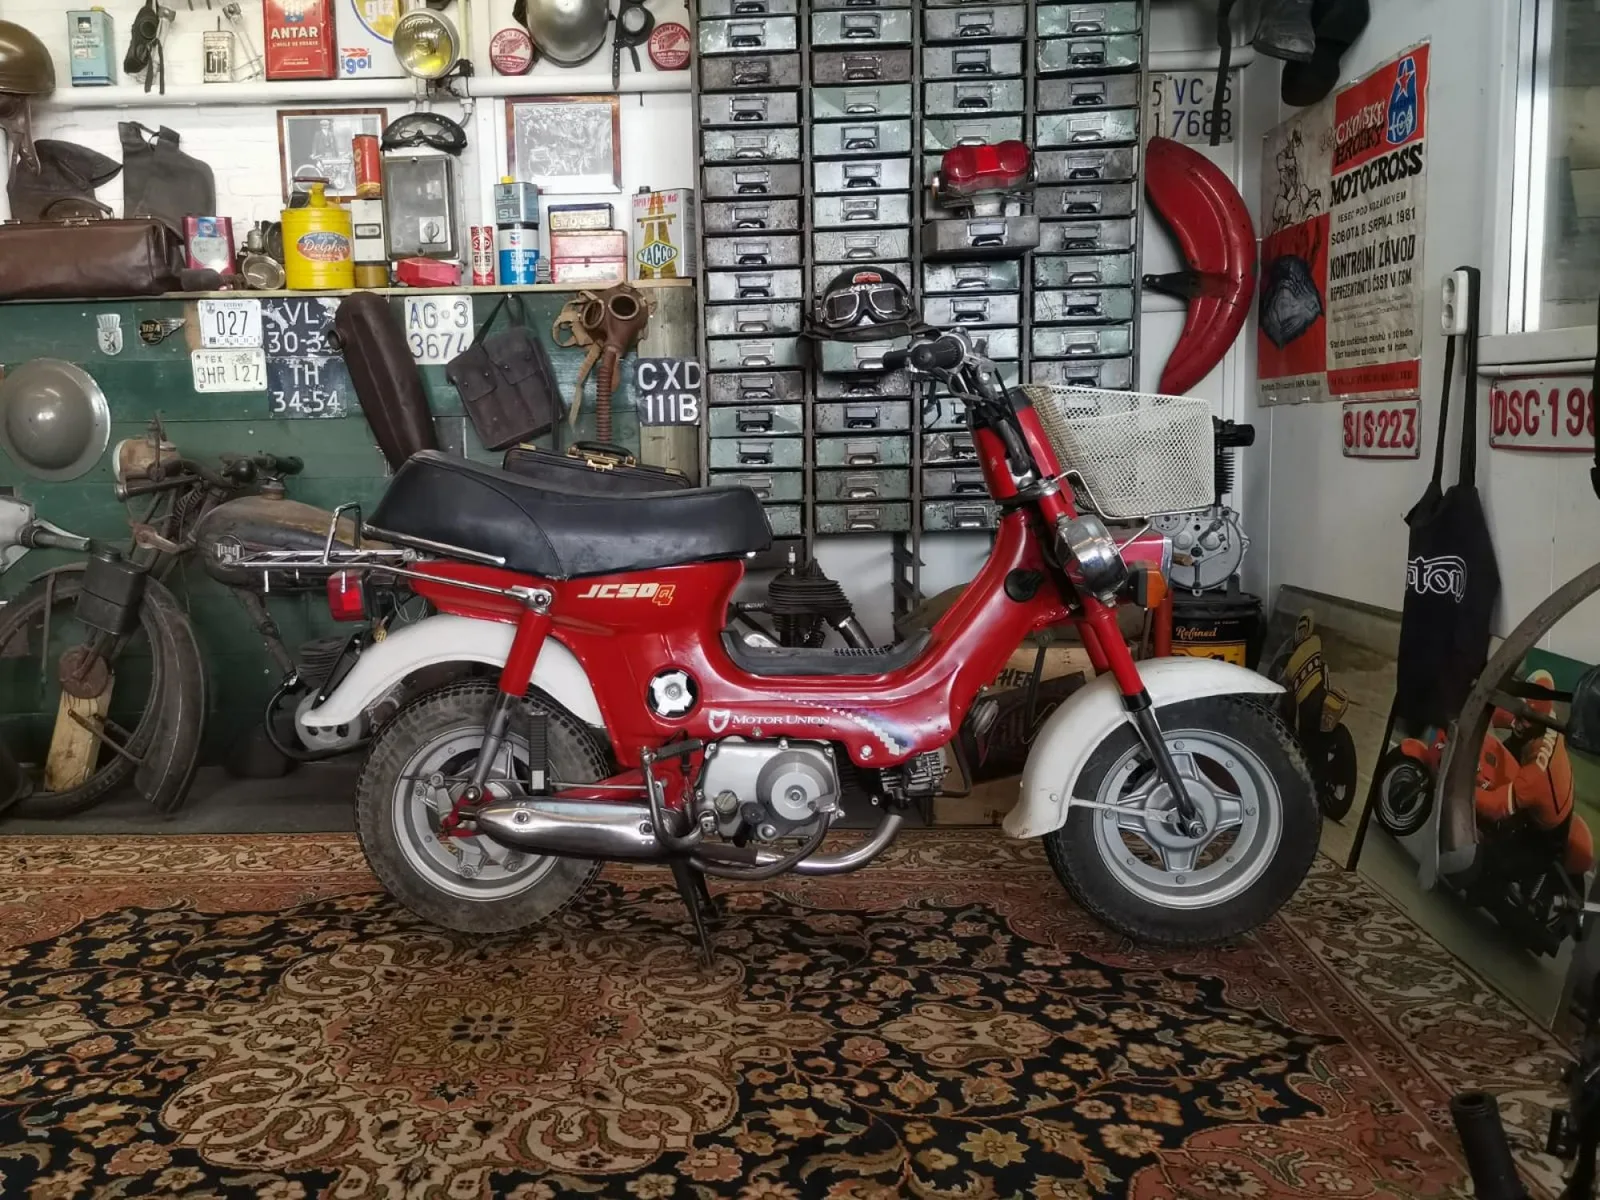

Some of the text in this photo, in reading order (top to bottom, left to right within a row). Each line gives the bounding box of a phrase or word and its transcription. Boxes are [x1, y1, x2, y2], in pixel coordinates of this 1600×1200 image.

[271, 26, 318, 39] ANTAR
[1152, 81, 1162, 107] 5
[1173, 78, 1204, 105] VC
[1172, 109, 1232, 137] 7688
[1329, 142, 1424, 208] MOTOCROSS
[499, 209, 519, 218] SL
[1331, 225, 1360, 246] SOBOTA
[1367, 213, 1393, 234] SRPNA
[1396, 206, 1416, 224] 1981
[640, 243, 673, 266] YACCO
[1330, 234, 1416, 281] KONTROLNÍ ZÁVOD
[1390, 271, 1397, 288] V
[216, 310, 248, 336] 027
[283, 301, 319, 326] VL
[409, 301, 469, 329] AG 3
[268, 331, 329, 353] 30-3
[410, 333, 467, 359] 3674
[197, 364, 260, 384] 3HR 127
[289, 364, 319, 386] TH
[638, 361, 700, 390] CXD
[273, 390, 341, 412] 34-54
[645, 393, 699, 423] 111B
[1175, 625, 1218, 640] Refined
